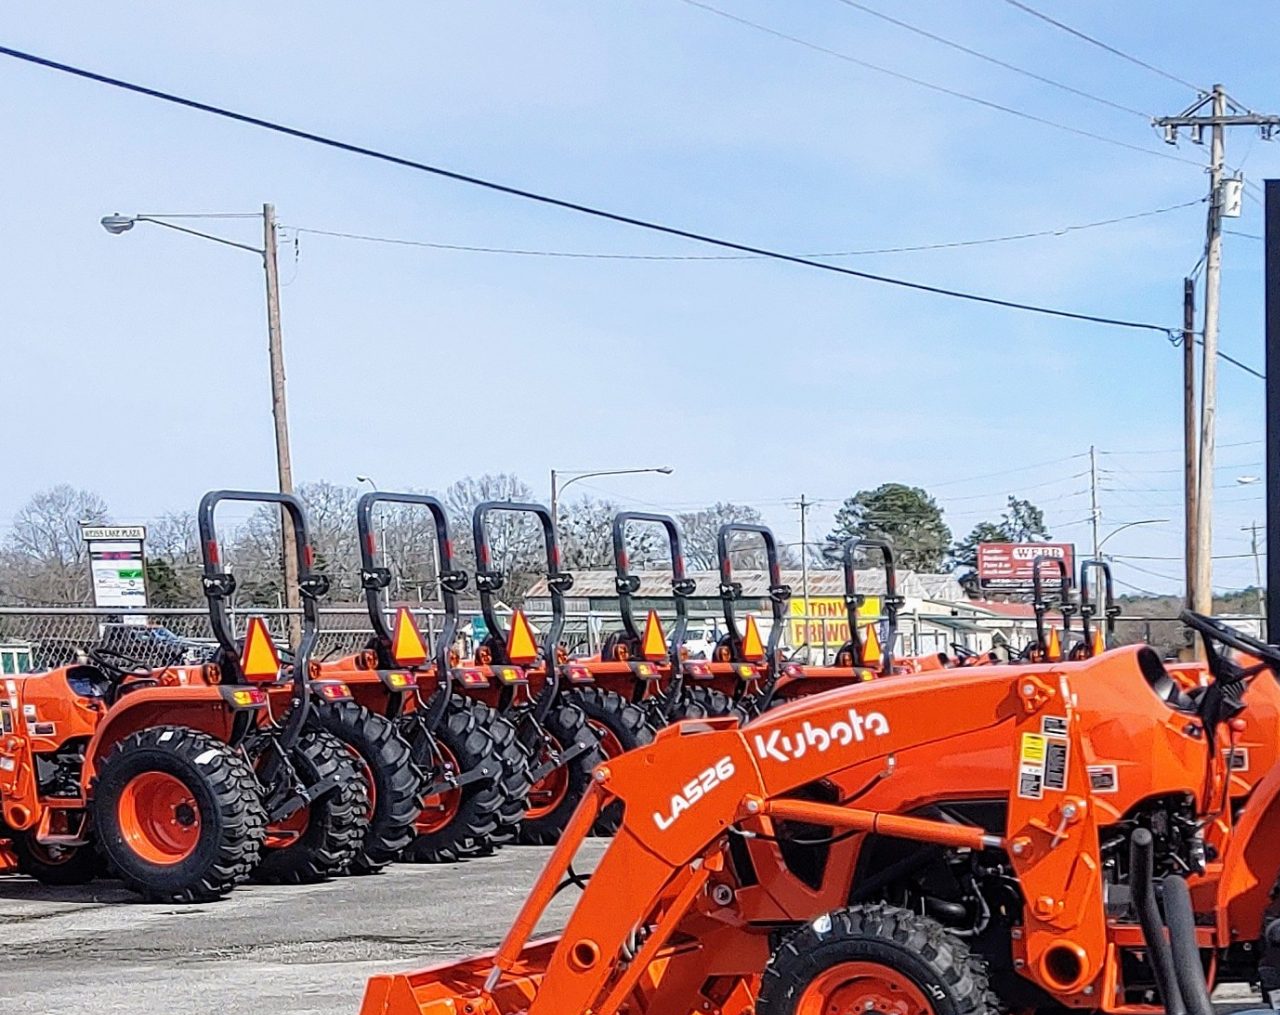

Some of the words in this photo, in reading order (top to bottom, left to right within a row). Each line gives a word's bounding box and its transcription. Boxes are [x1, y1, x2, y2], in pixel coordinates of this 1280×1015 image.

[121, 529, 141, 537] PLAZA
[754, 708, 890, 763] Kubota
[652, 755, 737, 831] LA526
